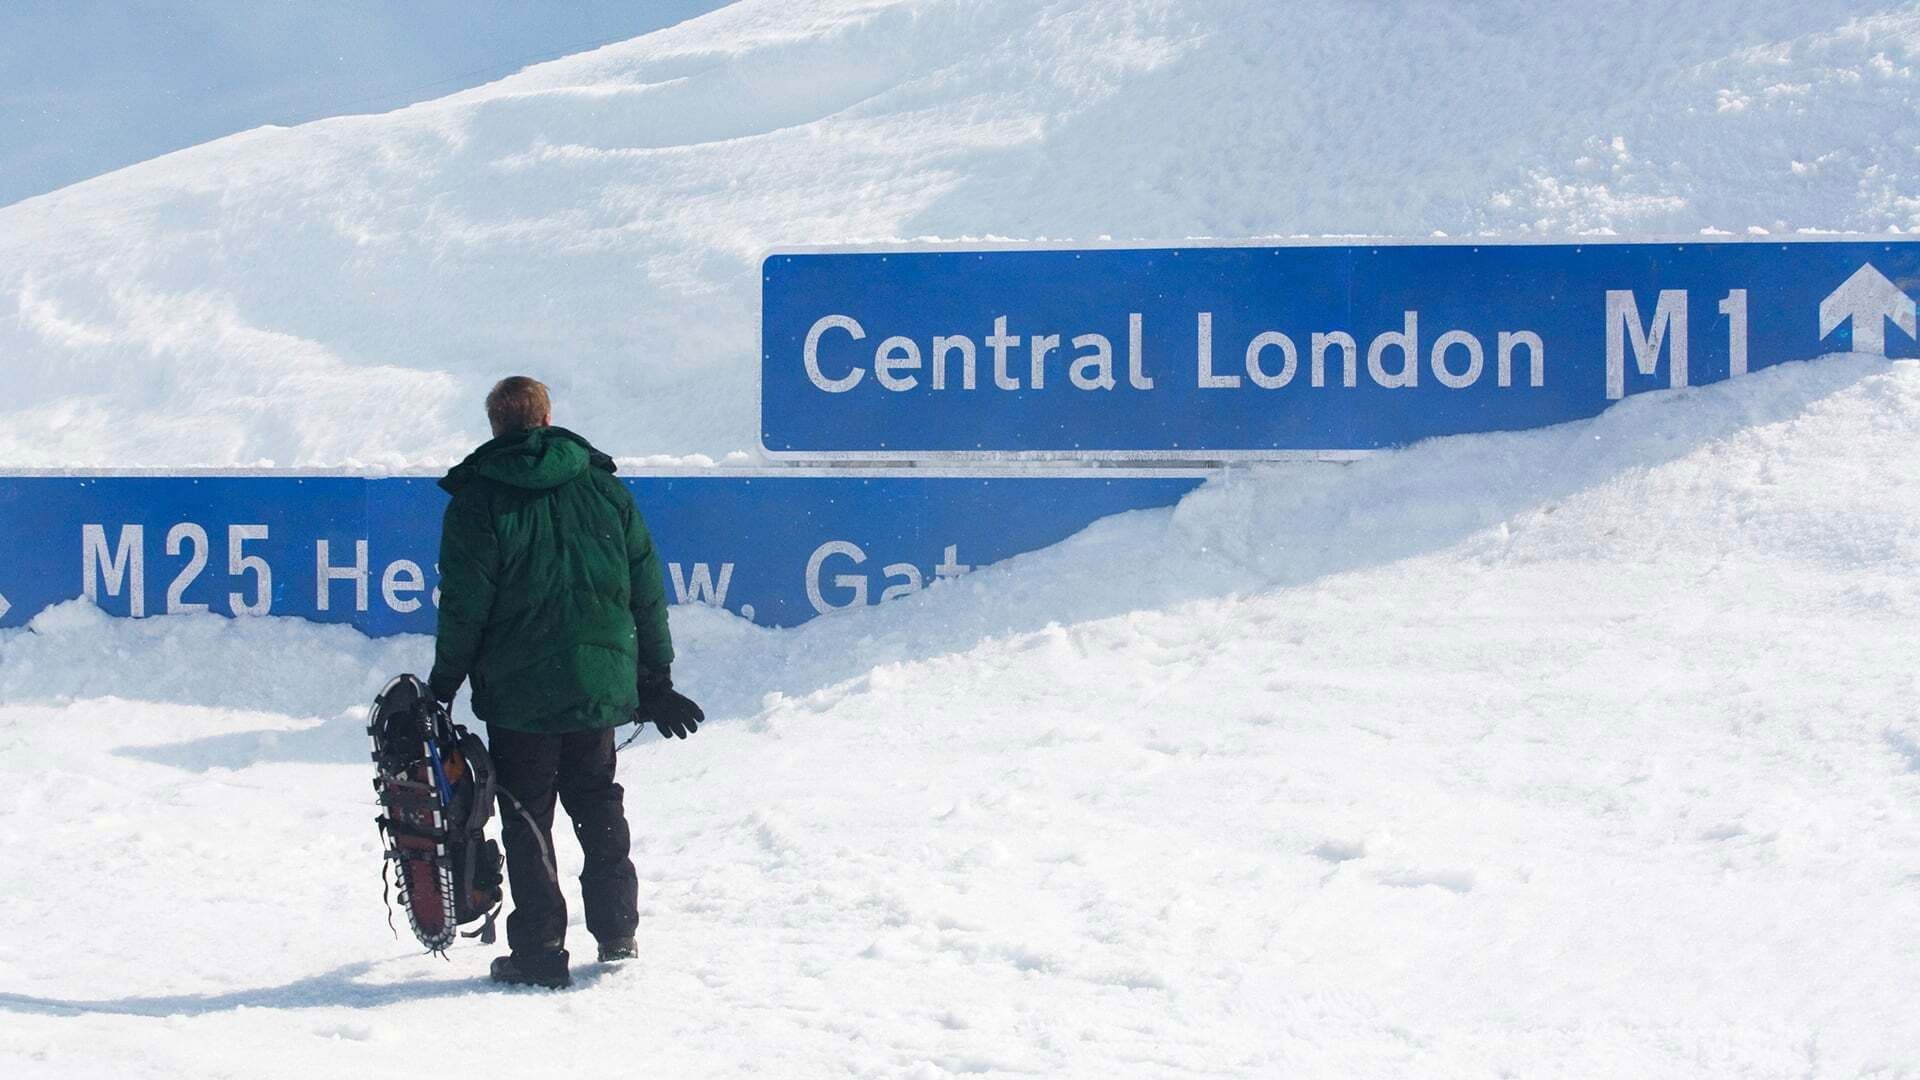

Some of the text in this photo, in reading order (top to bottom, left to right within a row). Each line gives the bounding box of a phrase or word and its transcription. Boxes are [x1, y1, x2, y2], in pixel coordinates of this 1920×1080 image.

[803, 288, 1748, 400] Central London M1
[82, 522, 272, 618] M25
[316, 539, 441, 613] He
[805, 540, 991, 615] Gat
